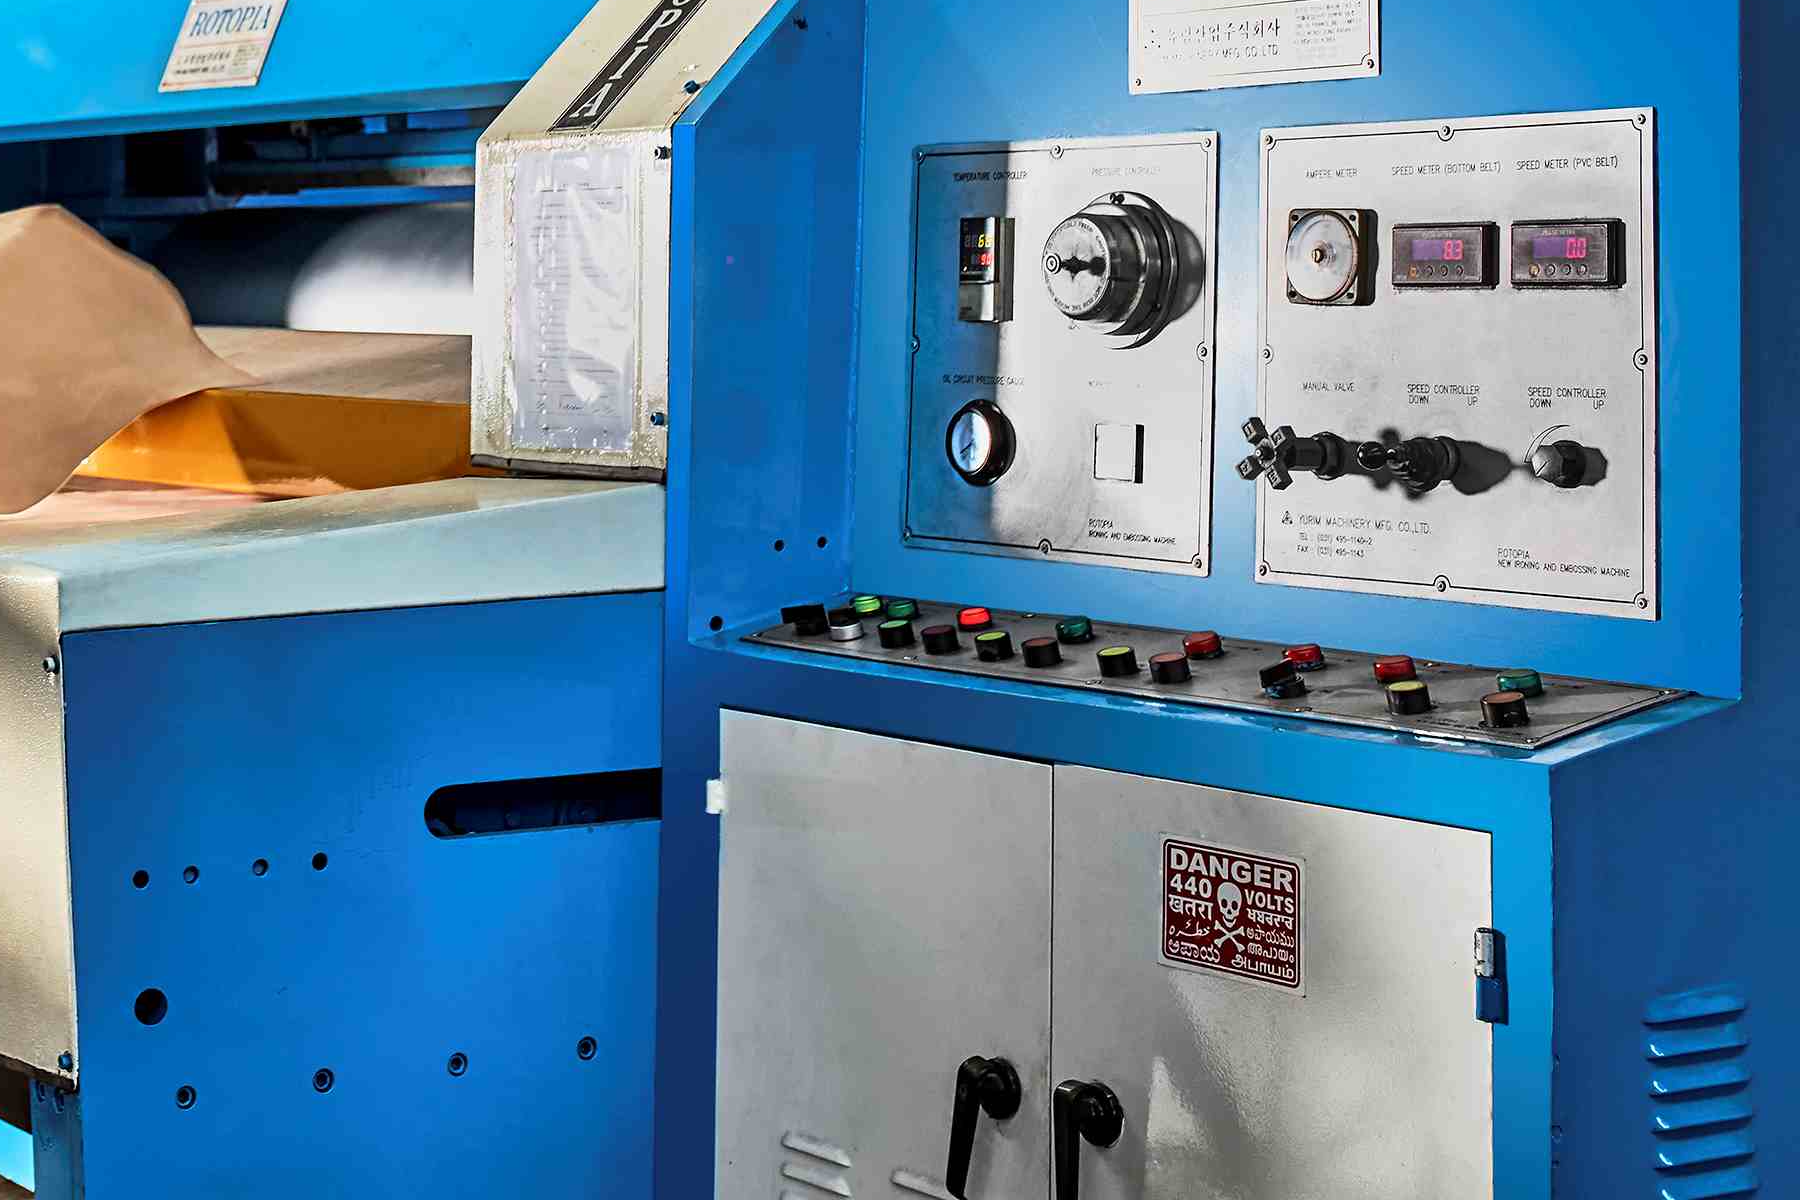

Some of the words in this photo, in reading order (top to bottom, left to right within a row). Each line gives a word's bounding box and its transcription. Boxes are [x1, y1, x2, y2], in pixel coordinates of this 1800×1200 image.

[188, 4, 273, 37] ROTOPIA
[1392, 165, 1414, 175] SPEED
[1418, 164, 1441, 175] METER
[1444, 162, 1476, 175] (BOTTOM
[1479, 161, 1501, 173] BELT)
[1516, 160, 1540, 170] SPEED
[1544, 158, 1569, 169] METER
[1573, 156, 1592, 169] (PVC
[1595, 155, 1618, 168] BELT)
[1335, 167, 1358, 177] METER
[1303, 382, 1330, 392] MANUAL
[1334, 382, 1355, 392] VALVE
[1407, 384, 1430, 394] SPEED
[1433, 384, 1480, 394] CONTROLLER
[1527, 387, 1552, 397] SPEED
[1556, 388, 1606, 399] CONTROLLER
[1408, 395, 1429, 404] DOWN
[1467, 396, 1478, 406] UP
[1529, 398, 1551, 408] DOWN
[1593, 400, 1604, 410] UP
[1497, 548, 1530, 559] ROTOPIA
[1497, 559, 1510, 568] NEW
[1514, 560, 1540, 570] IRONING
[1543, 563, 1557, 572] AND
[1560, 563, 1598, 575] EMBOSSING
[1600, 567, 1631, 578] MACHINE
[1170, 847, 1294, 893] DANGER
[1170, 873, 1212, 898] 440
[1168, 894, 1213, 921] खतरा
[1244, 888, 1294, 914] VOLTS
[1231, 953, 1294, 980] அபாயம்
